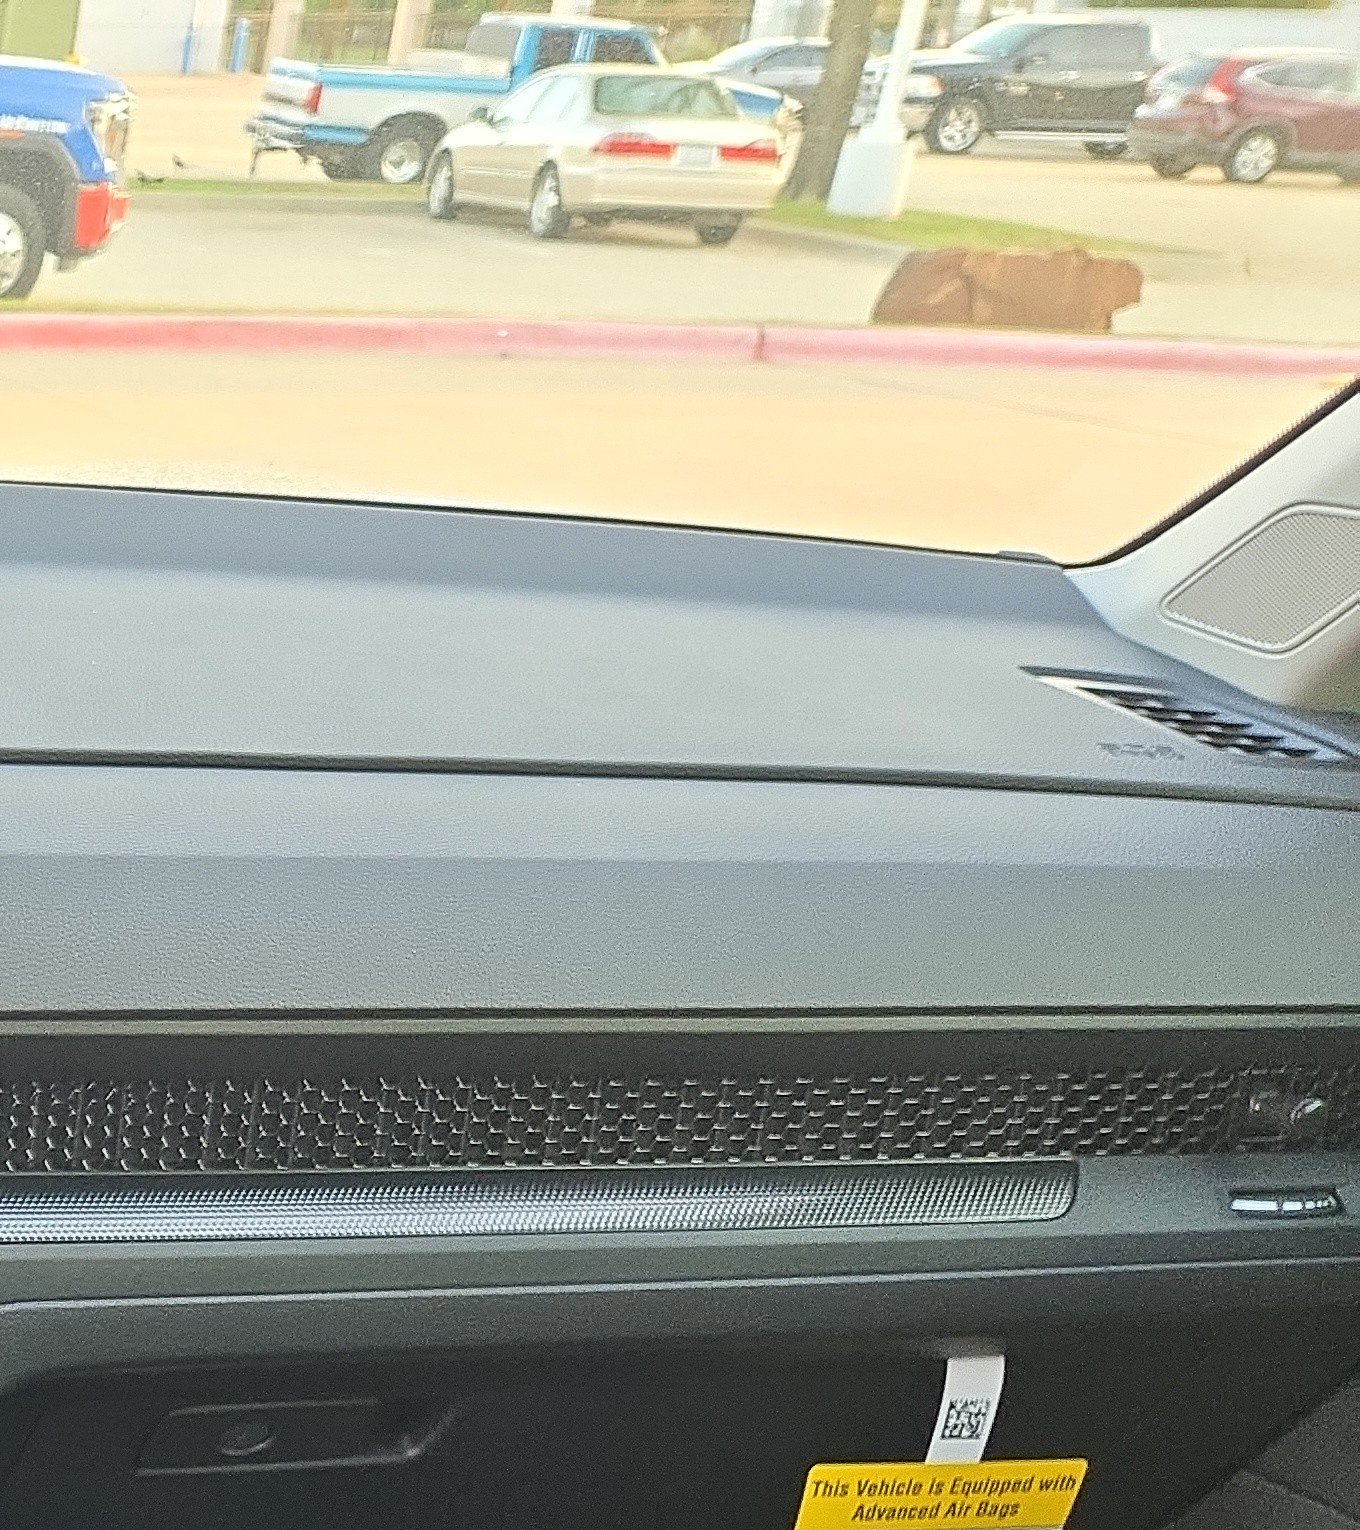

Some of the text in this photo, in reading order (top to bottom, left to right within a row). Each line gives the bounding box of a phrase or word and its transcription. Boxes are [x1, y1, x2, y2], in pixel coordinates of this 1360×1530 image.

[811, 1473, 1077, 1498] This Vehicle is Equipped with
[851, 1501, 1020, 1522] Advanced Air Bags
